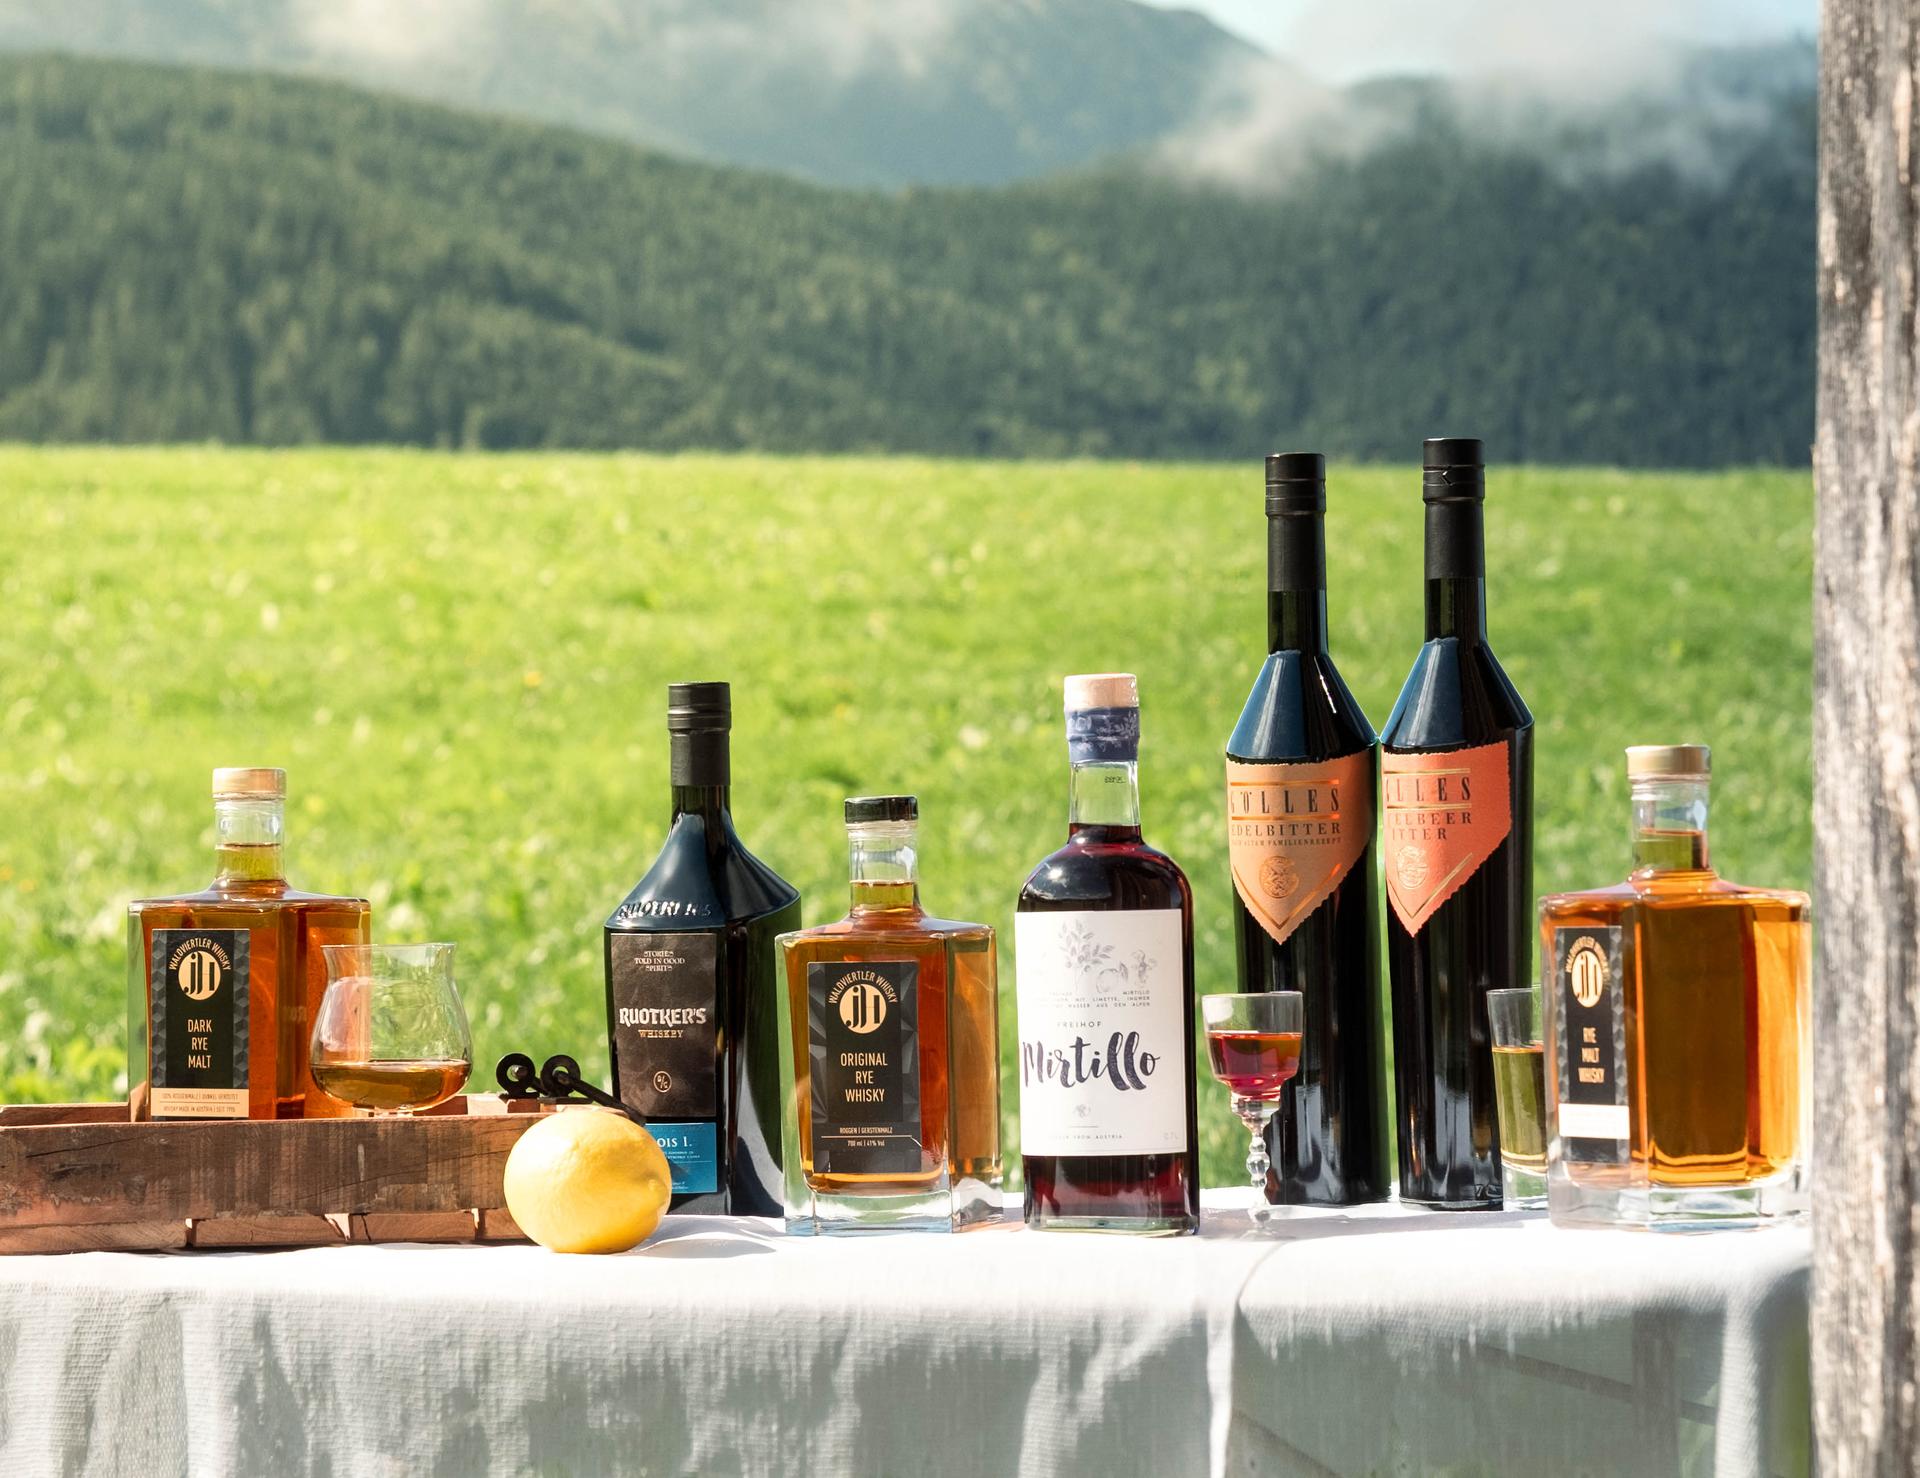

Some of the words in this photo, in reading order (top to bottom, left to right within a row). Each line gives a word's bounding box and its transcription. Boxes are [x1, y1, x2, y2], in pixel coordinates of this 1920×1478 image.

[169, 937, 212, 971] WALDVIERTLER
[211, 942, 232, 971] WHISKY
[828, 970, 876, 1004] WALDVIERTLER
[876, 975, 898, 1003] WHISKY
[619, 1007, 707, 1028] RUOTKER'S
[187, 1019, 213, 1033] DARK
[638, 1029, 684, 1038] WHISKEY
[191, 1037, 208, 1051] RYE
[188, 1055, 212, 1069] MALT
[840, 1052, 888, 1066] ORIGINAL
[1022, 1031, 1161, 1091] Mirtillo
[855, 1070, 874, 1084] RYE
[845, 1088, 885, 1102] WHISKY
[656, 1137, 678, 1148] OIS
